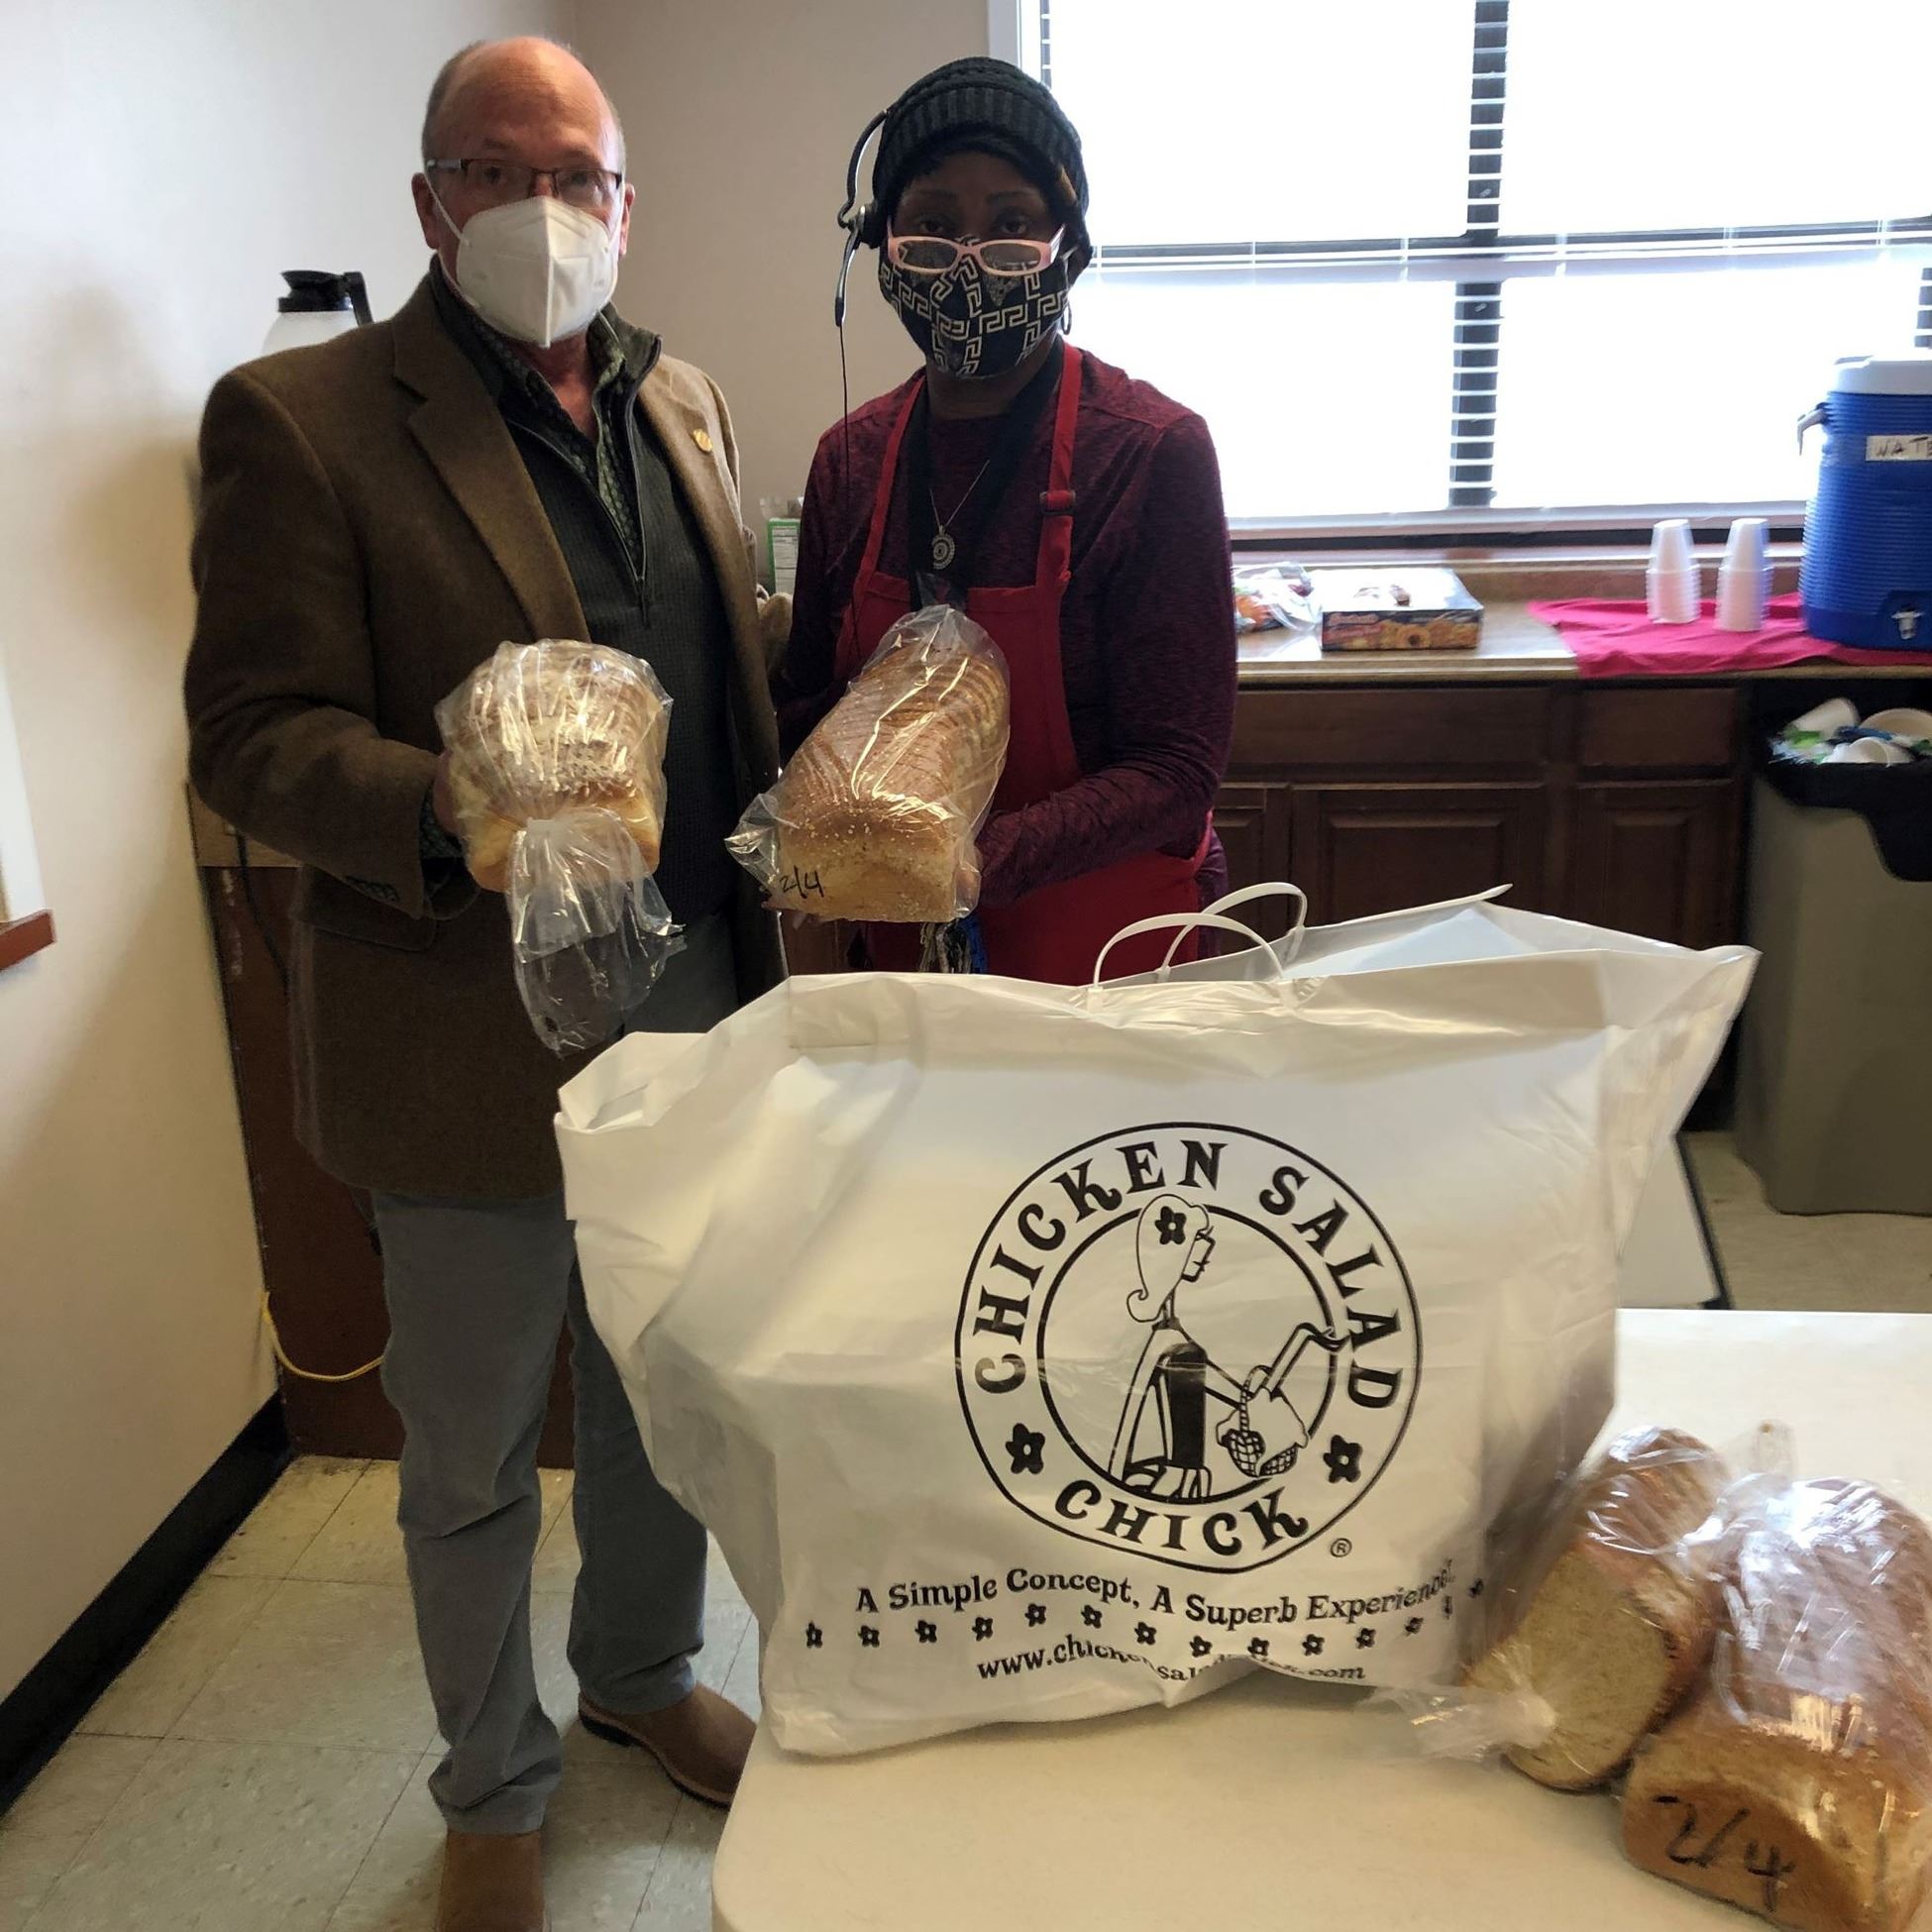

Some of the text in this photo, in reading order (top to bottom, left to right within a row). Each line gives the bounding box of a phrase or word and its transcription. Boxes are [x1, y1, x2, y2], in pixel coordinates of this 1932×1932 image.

[779, 864, 825, 900] 2/4
[974, 1139, 1402, 1409] CHICKEN SALAD
[1054, 1479, 1309, 1556] CHICK
[856, 1587, 879, 1613] A
[889, 1575, 998, 1612] Simple
[1006, 1567, 1140, 1609] Concept,
[1149, 1585, 1174, 1614] A
[1185, 1594, 1298, 1632] Superb
[1653, 1794, 1796, 1913] 2/4
